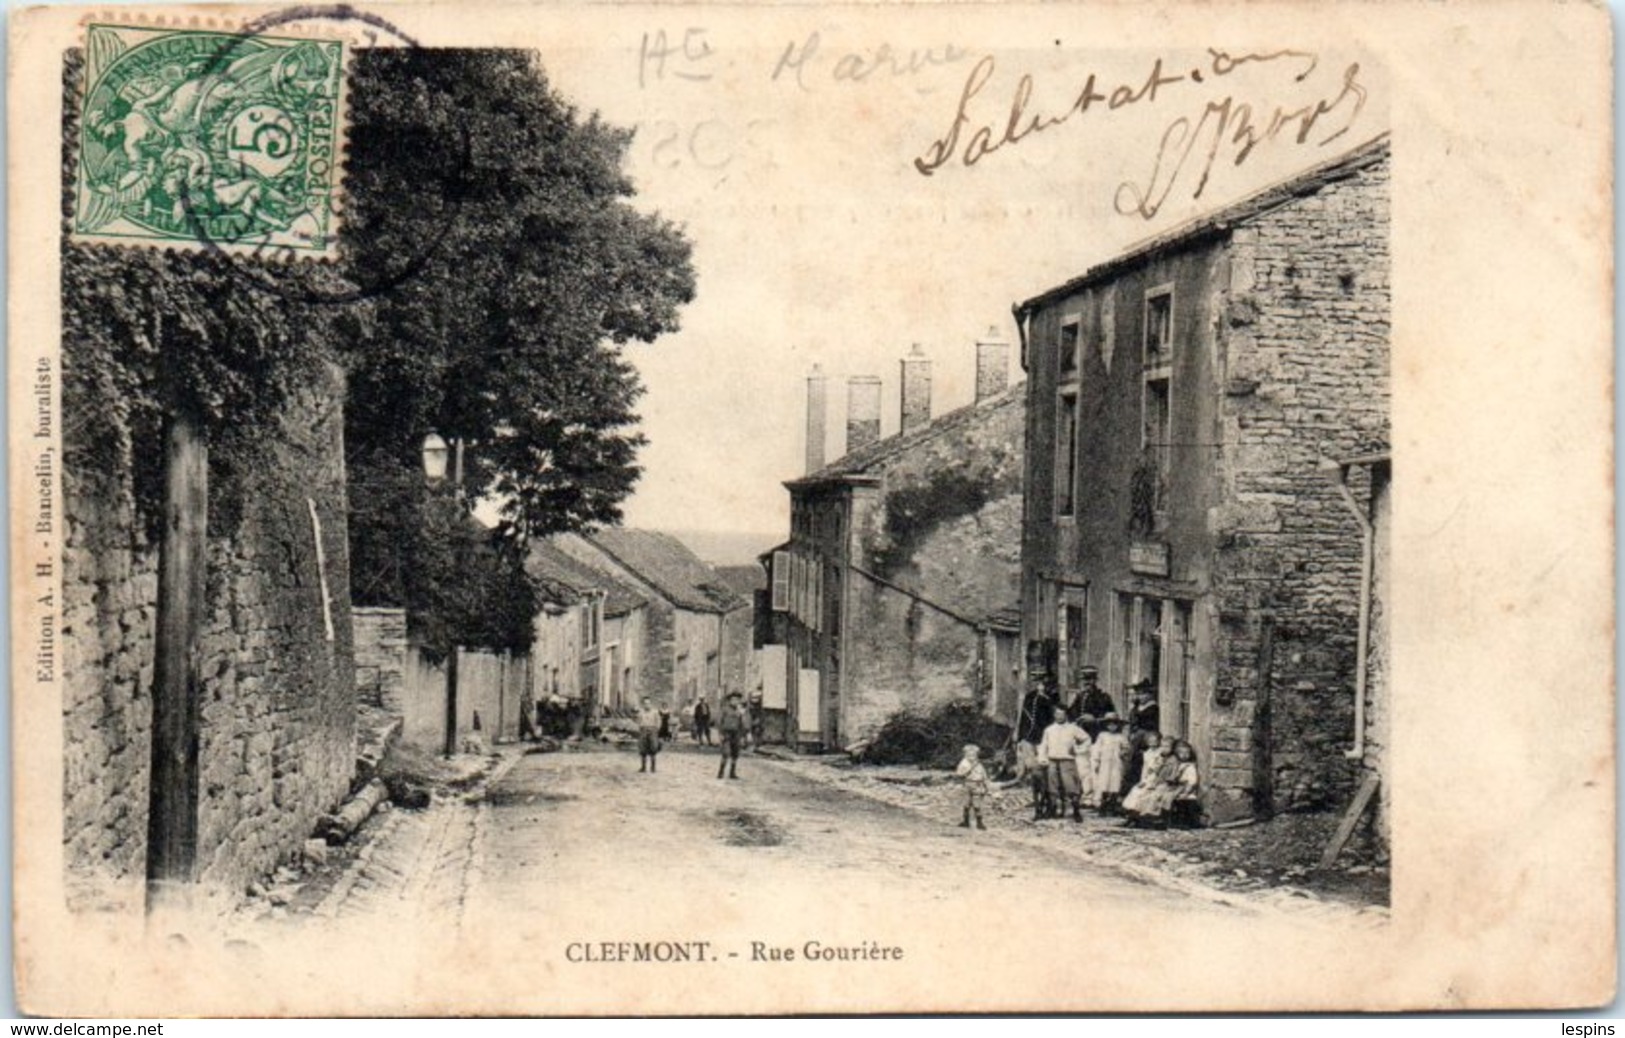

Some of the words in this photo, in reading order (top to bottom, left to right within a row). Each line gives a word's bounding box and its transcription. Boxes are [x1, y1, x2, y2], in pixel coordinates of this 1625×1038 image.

[308, 101, 333, 191] POSTES
[34, 356, 51, 438] buraliste
[35, 556, 53, 577] H.
[37, 587, 54, 607] A.
[37, 616, 54, 683] Edition
[565, 941, 718, 963] CLEFMONT.
[750, 940, 796, 962] Rue
[802, 940, 905, 962] Gourière
